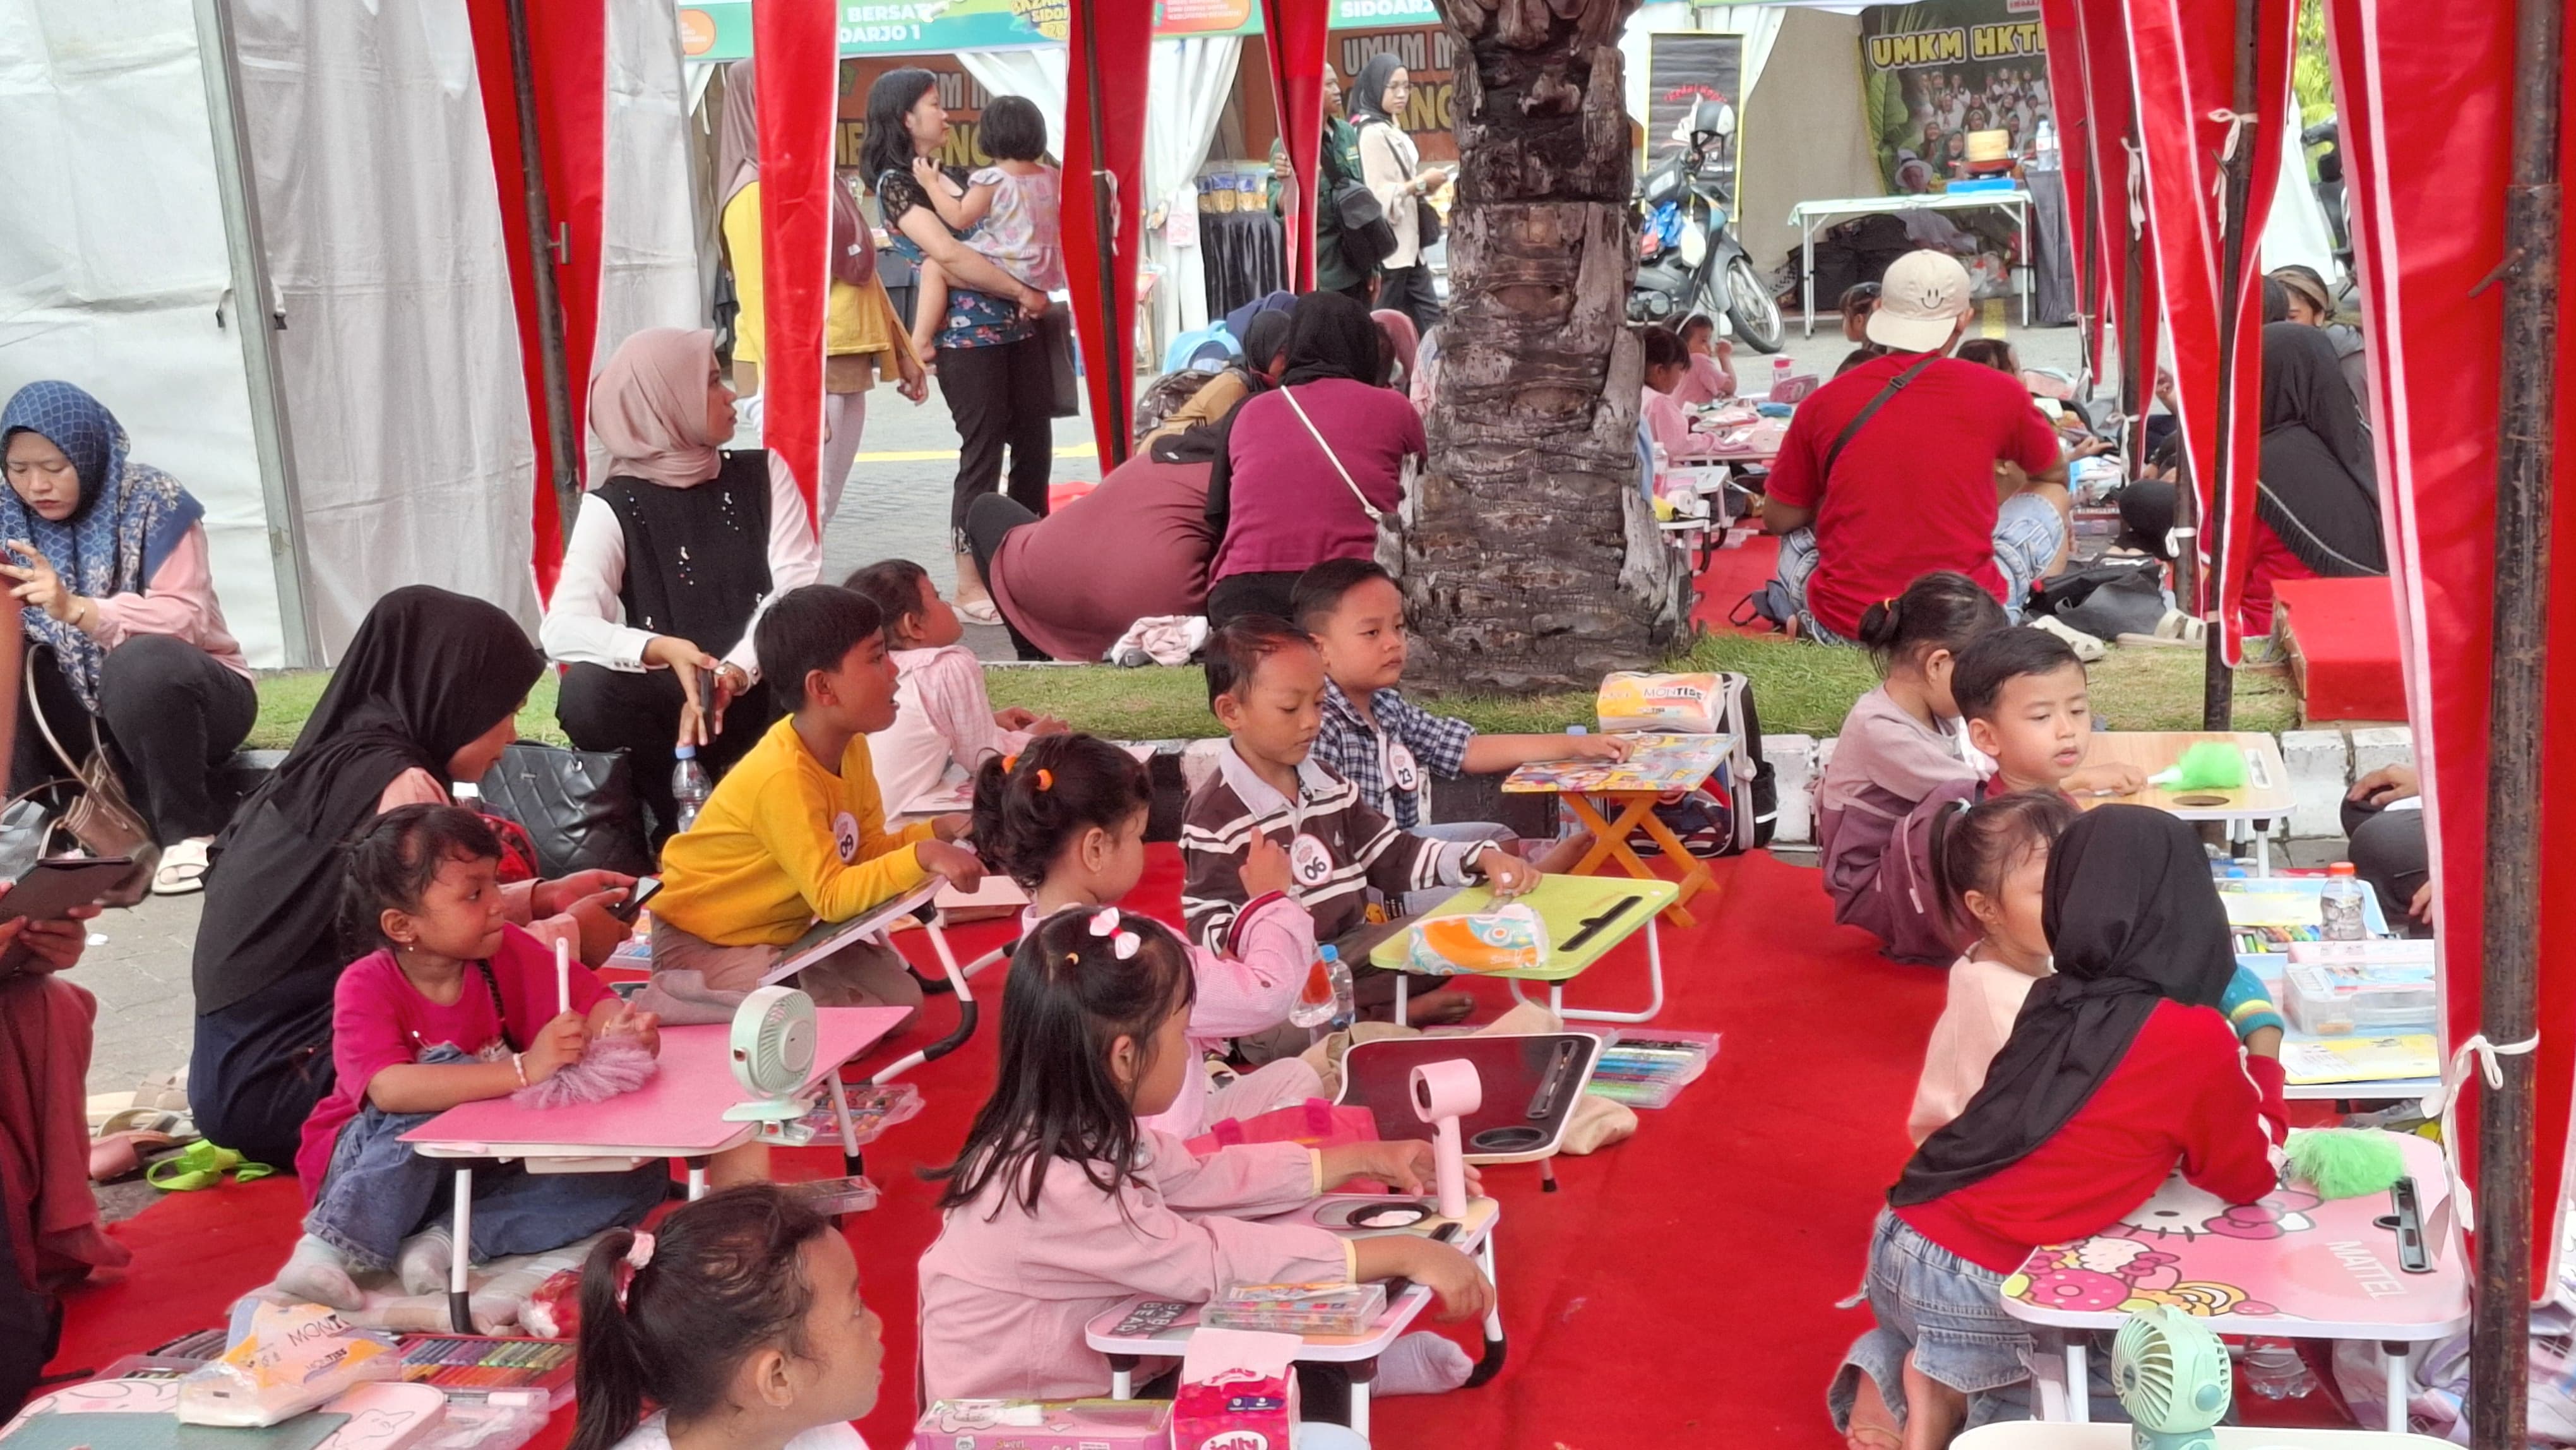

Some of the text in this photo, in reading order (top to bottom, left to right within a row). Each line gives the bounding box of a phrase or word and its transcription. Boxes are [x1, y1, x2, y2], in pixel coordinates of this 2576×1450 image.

[847, 4, 933, 23] BERSAT
[1340, 0, 1435, 18] SIDOARJ
[1869, 30, 1962, 66] UMKM
[1398, 767, 1413, 785] 23
[840, 834, 854, 858] 09
[1304, 856, 1327, 880] 06
[2325, 1240, 2408, 1300] MATTEL
